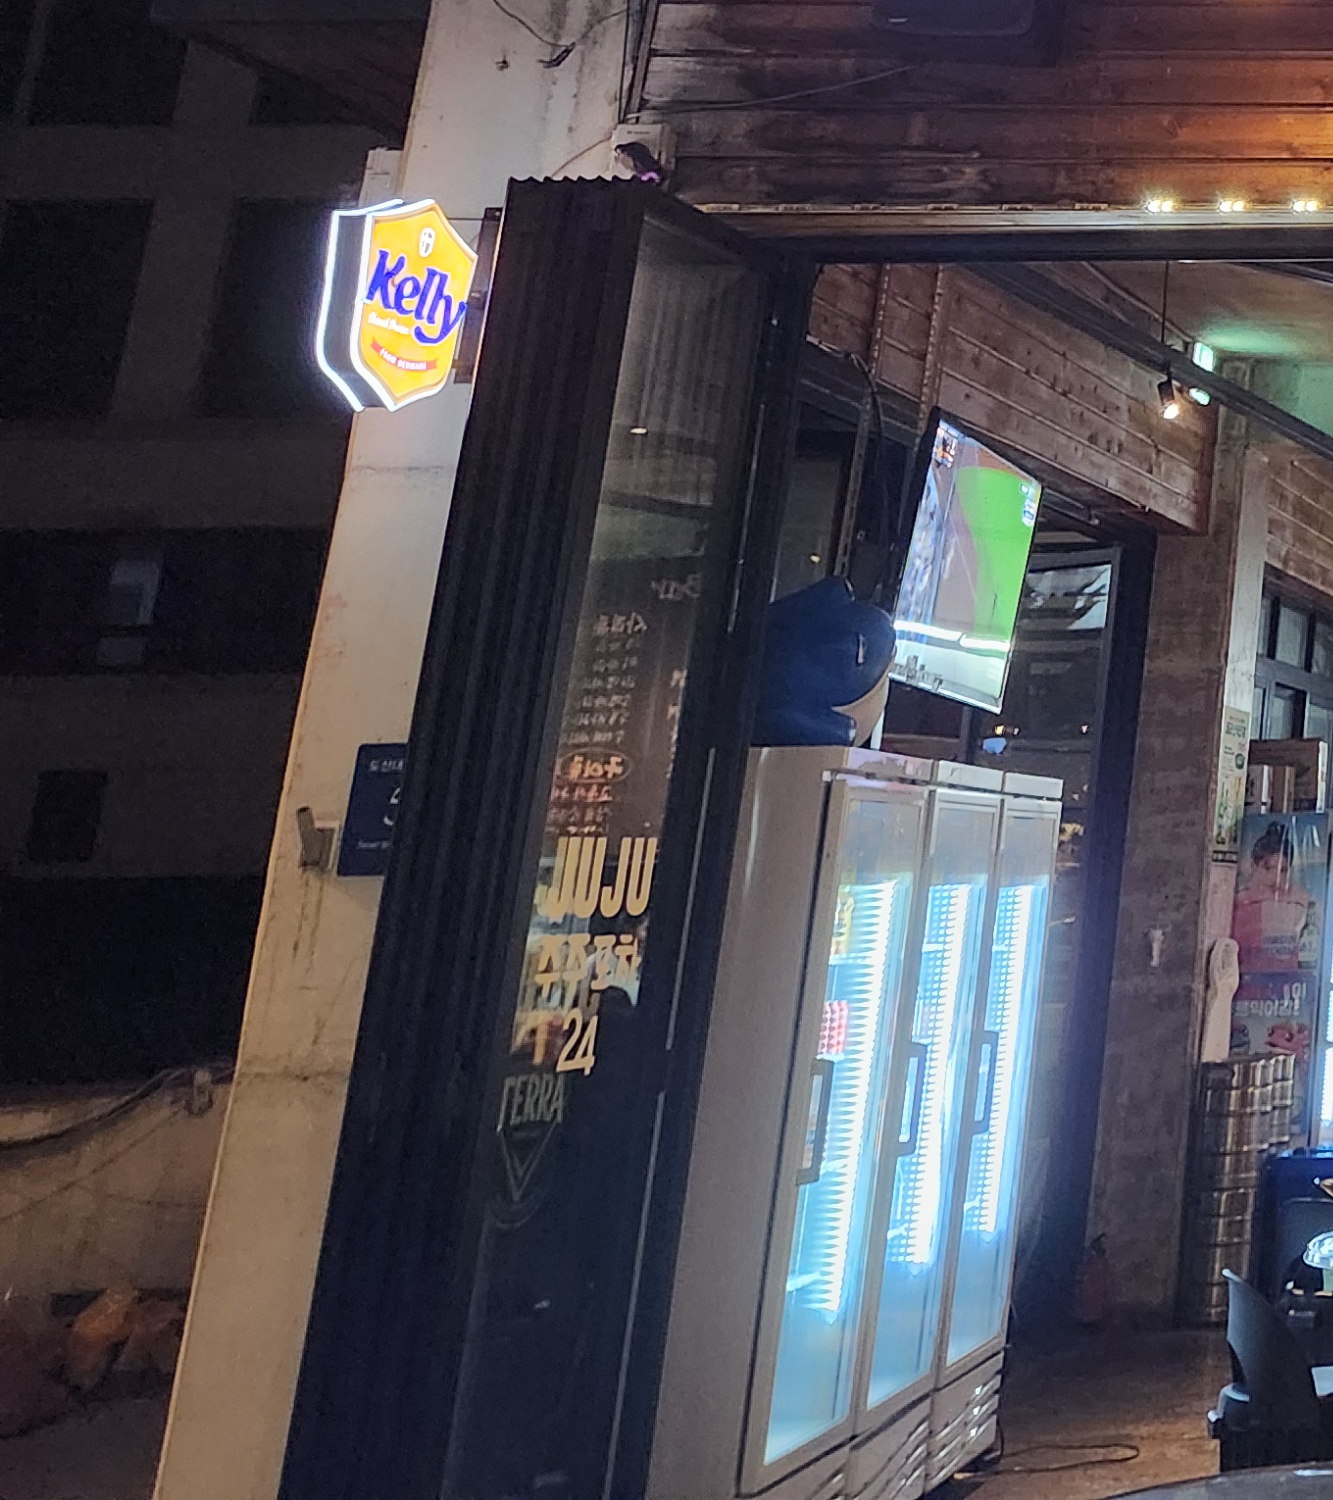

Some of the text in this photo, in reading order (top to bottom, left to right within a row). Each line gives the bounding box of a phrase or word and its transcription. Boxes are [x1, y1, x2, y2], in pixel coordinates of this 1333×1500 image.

[365, 250, 468, 344] Kelly
[538, 836, 658, 919] JUJU
[556, 1008, 599, 1076] 24
